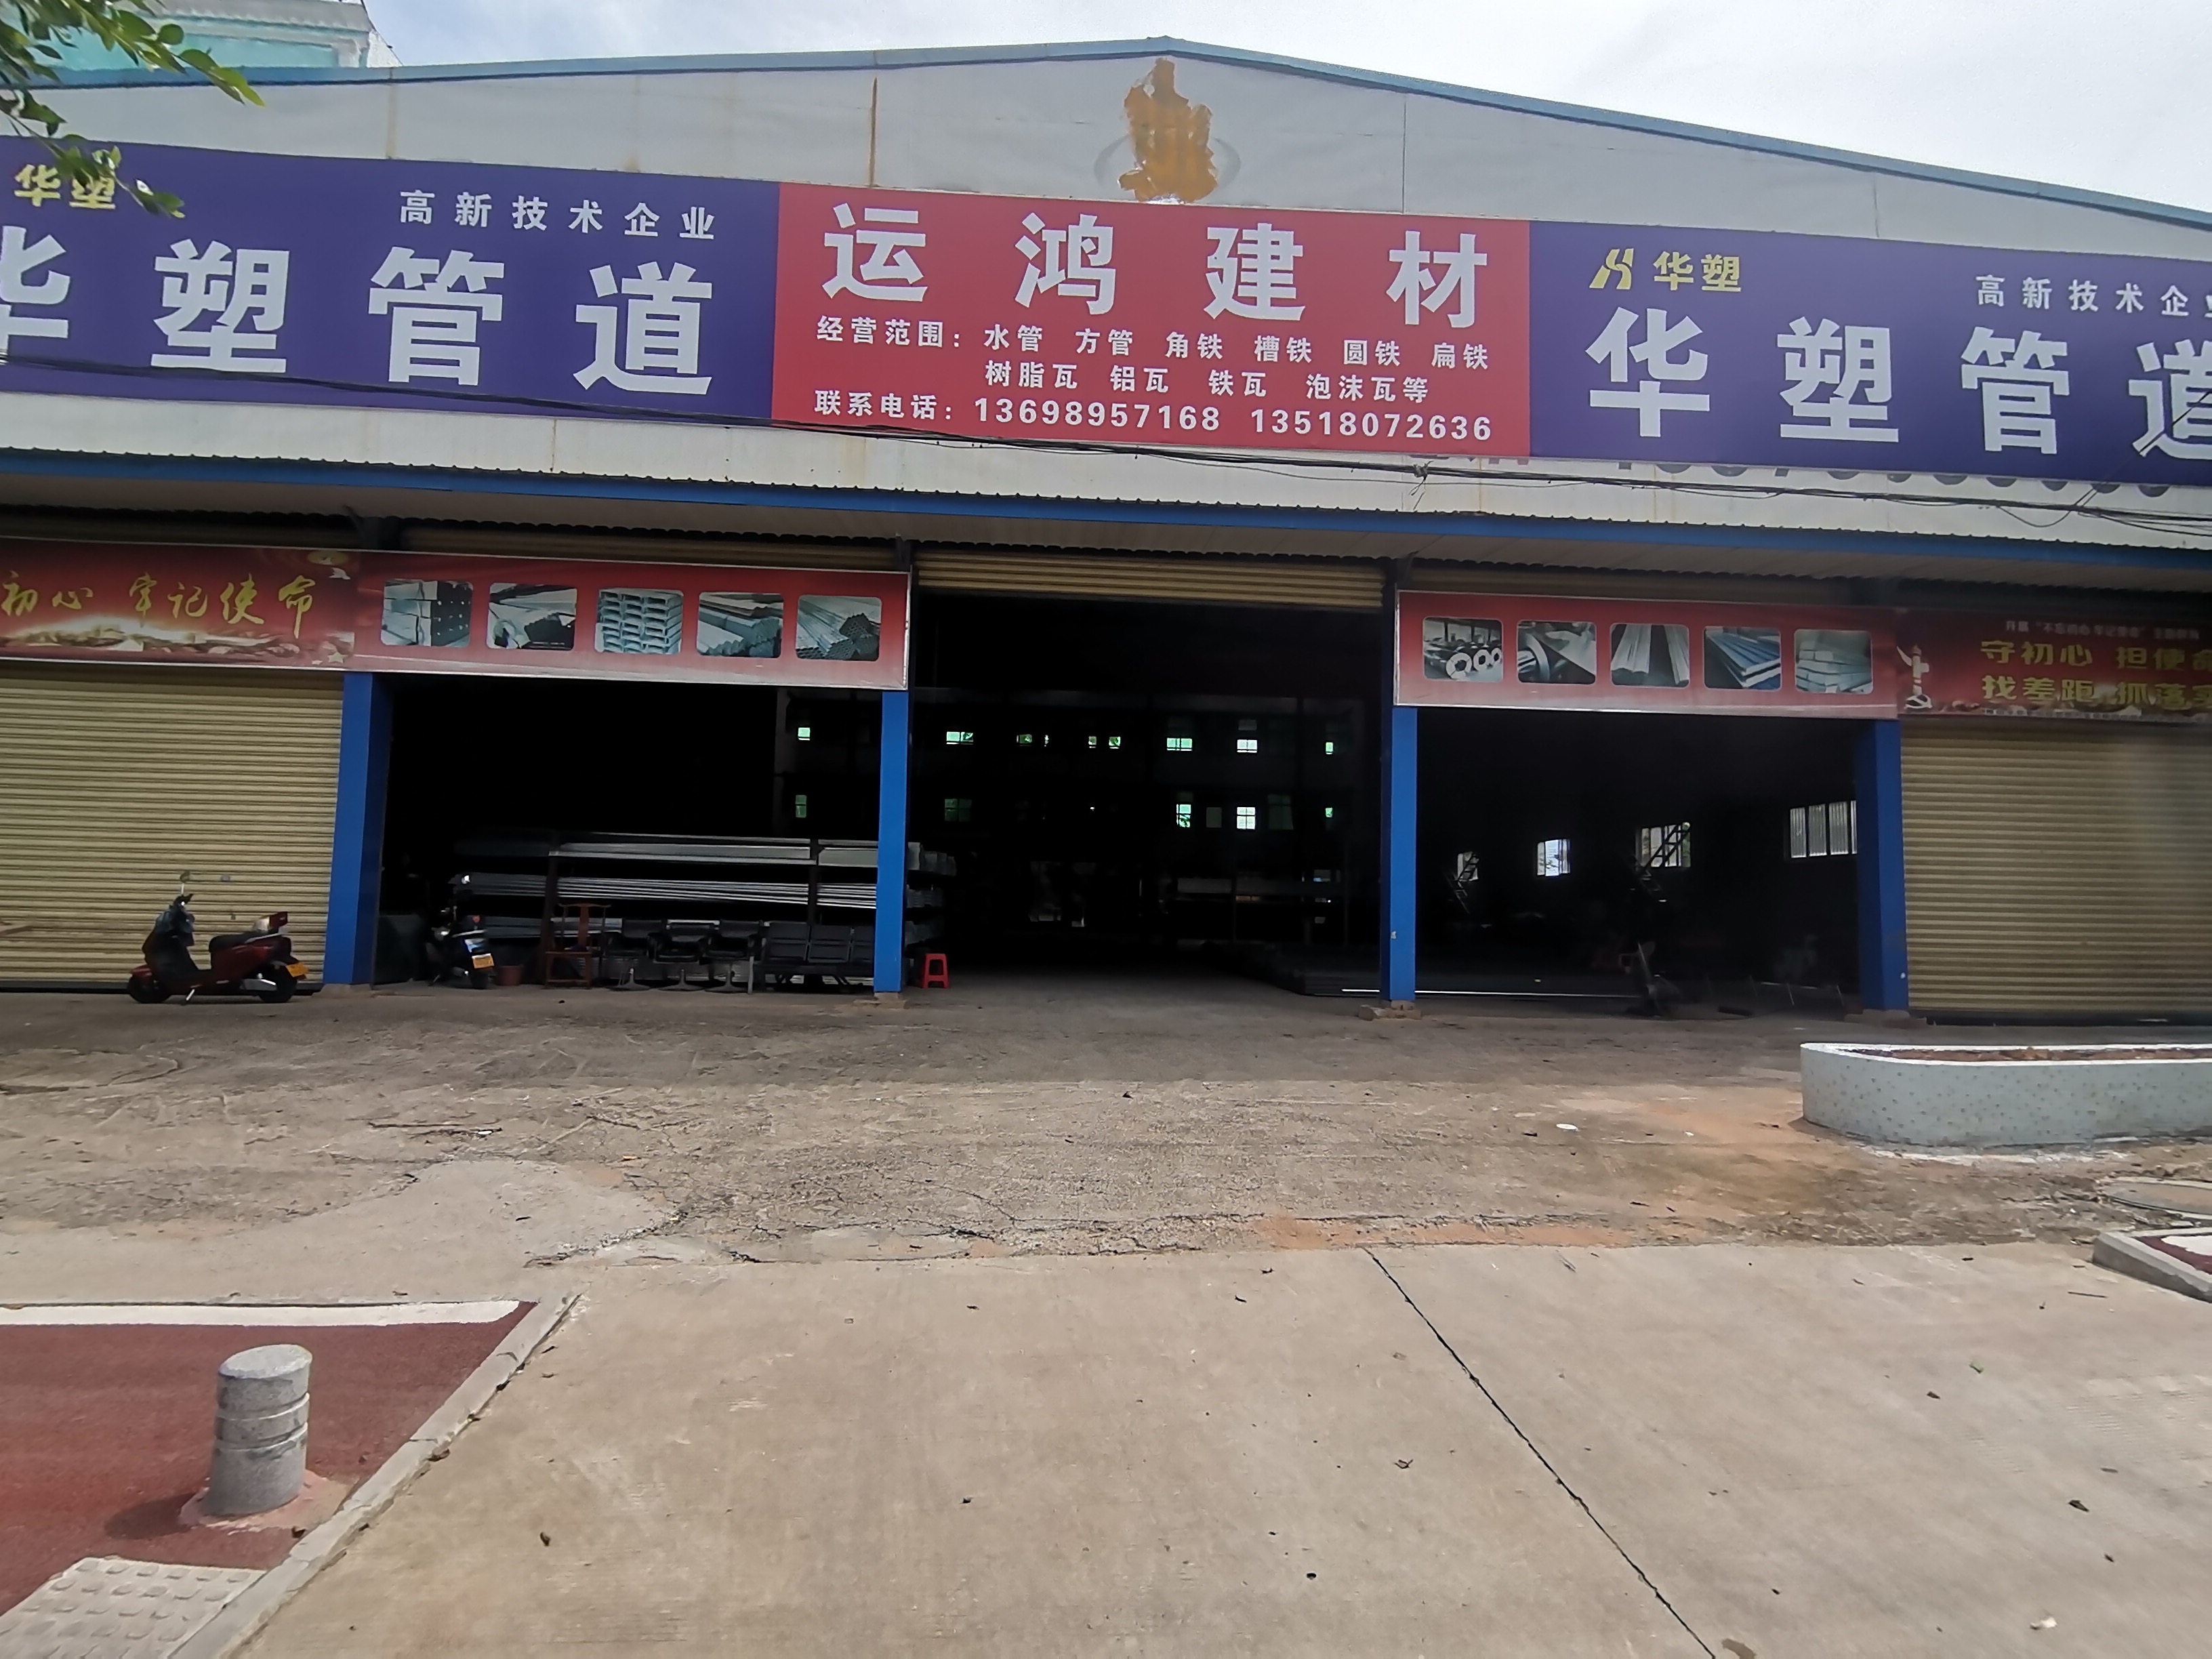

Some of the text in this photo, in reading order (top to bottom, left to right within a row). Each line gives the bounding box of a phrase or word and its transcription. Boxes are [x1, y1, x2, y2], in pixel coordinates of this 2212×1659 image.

[399, 188, 716, 241] 高新技术企业
[821, 201, 1489, 329] 运鸿建材
[1654, 251, 1740, 292] 华塑
[983, 323, 1044, 353] 水管
[1074, 327, 1134, 356] 方管
[1164, 331, 1224, 360] 角铁
[1253, 334, 1313, 364] 槽铁
[1343, 339, 1401, 367] 圆铁
[1430, 342, 1489, 371] 扁铁
[984, 359, 1429, 404] 树脂瓦 铝瓦 铁瓦 泡沫瓦等
[1584, 306, 2212, 461] 华塑管道
[974, 397, 1220, 432] 13698957168
[1250, 408, 1492, 441] 13518072636
[1, 571, 315, 638] 初心 牢记使命
[1980, 640, 2212, 672] 守初心 担使命
[1981, 674, 2094, 703] 找差距
